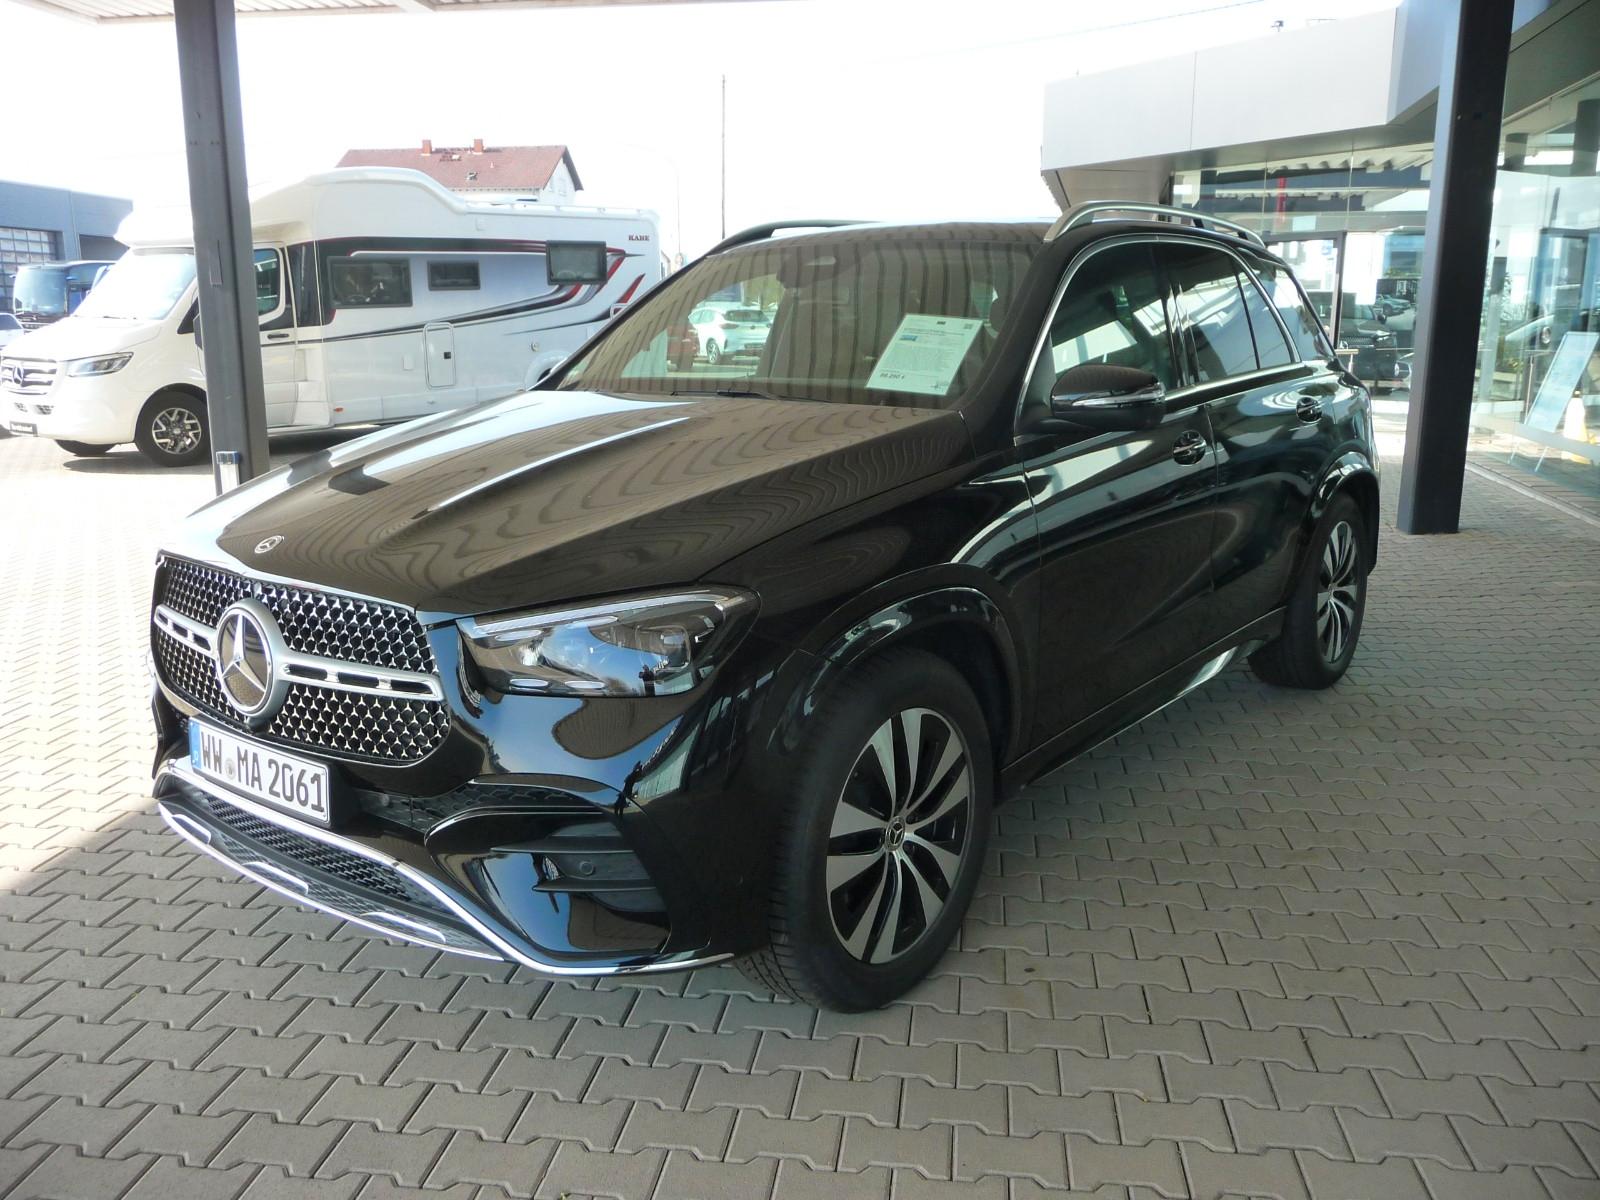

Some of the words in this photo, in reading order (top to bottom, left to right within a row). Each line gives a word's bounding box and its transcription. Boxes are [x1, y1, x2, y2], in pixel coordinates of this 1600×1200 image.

[201, 731, 222, 774] WW
[236, 745, 262, 791] MA
[267, 758, 325, 813] 2061
